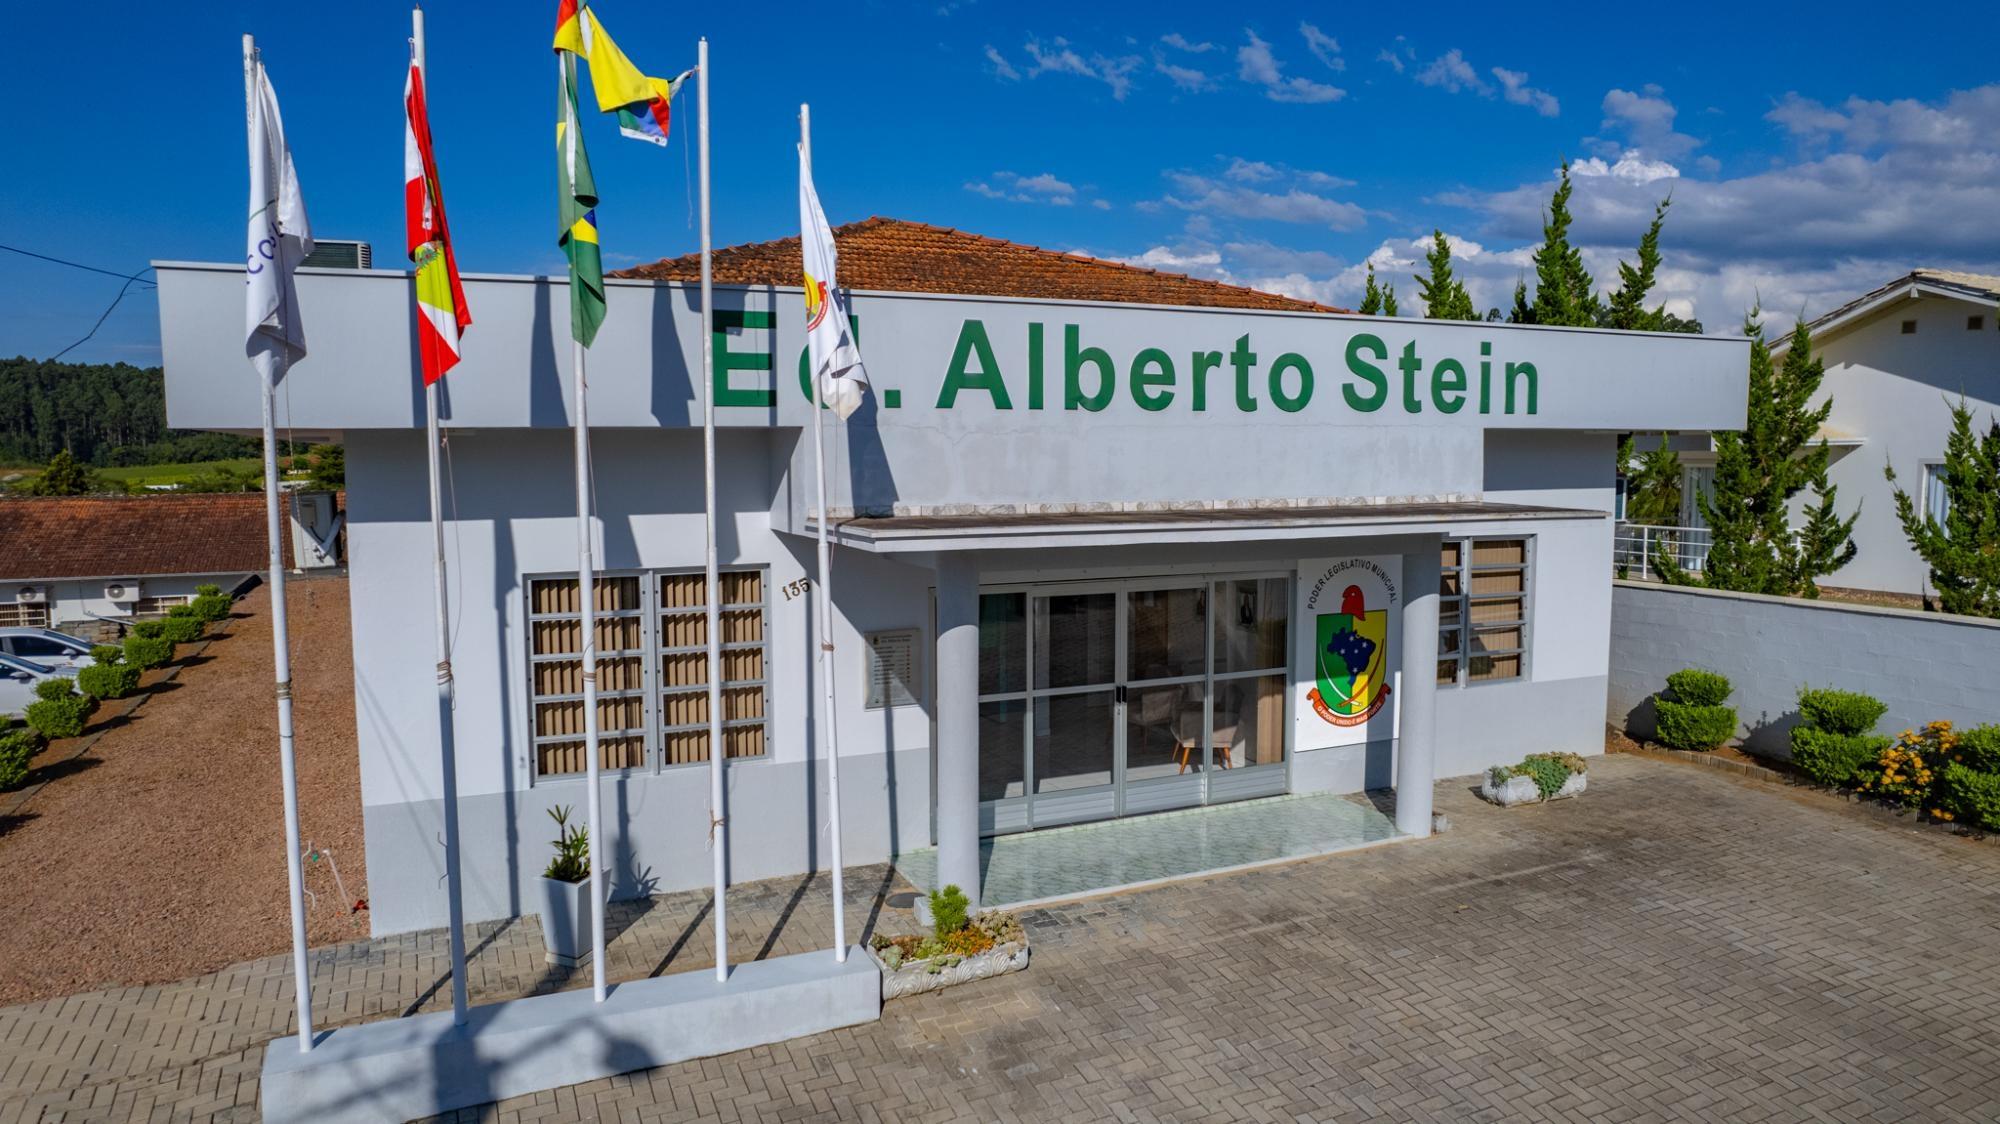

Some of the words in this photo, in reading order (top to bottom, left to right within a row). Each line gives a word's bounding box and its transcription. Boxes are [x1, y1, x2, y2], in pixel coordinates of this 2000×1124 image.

[935, 319, 1315, 412] Alberto
[1342, 333, 1539, 415] Stein
[782, 576, 810, 601] 135
[1307, 578, 1326, 610] PODER
[1323, 558, 1371, 582] LEGISLATIVO
[1371, 563, 1397, 604] MUNICIPAL
